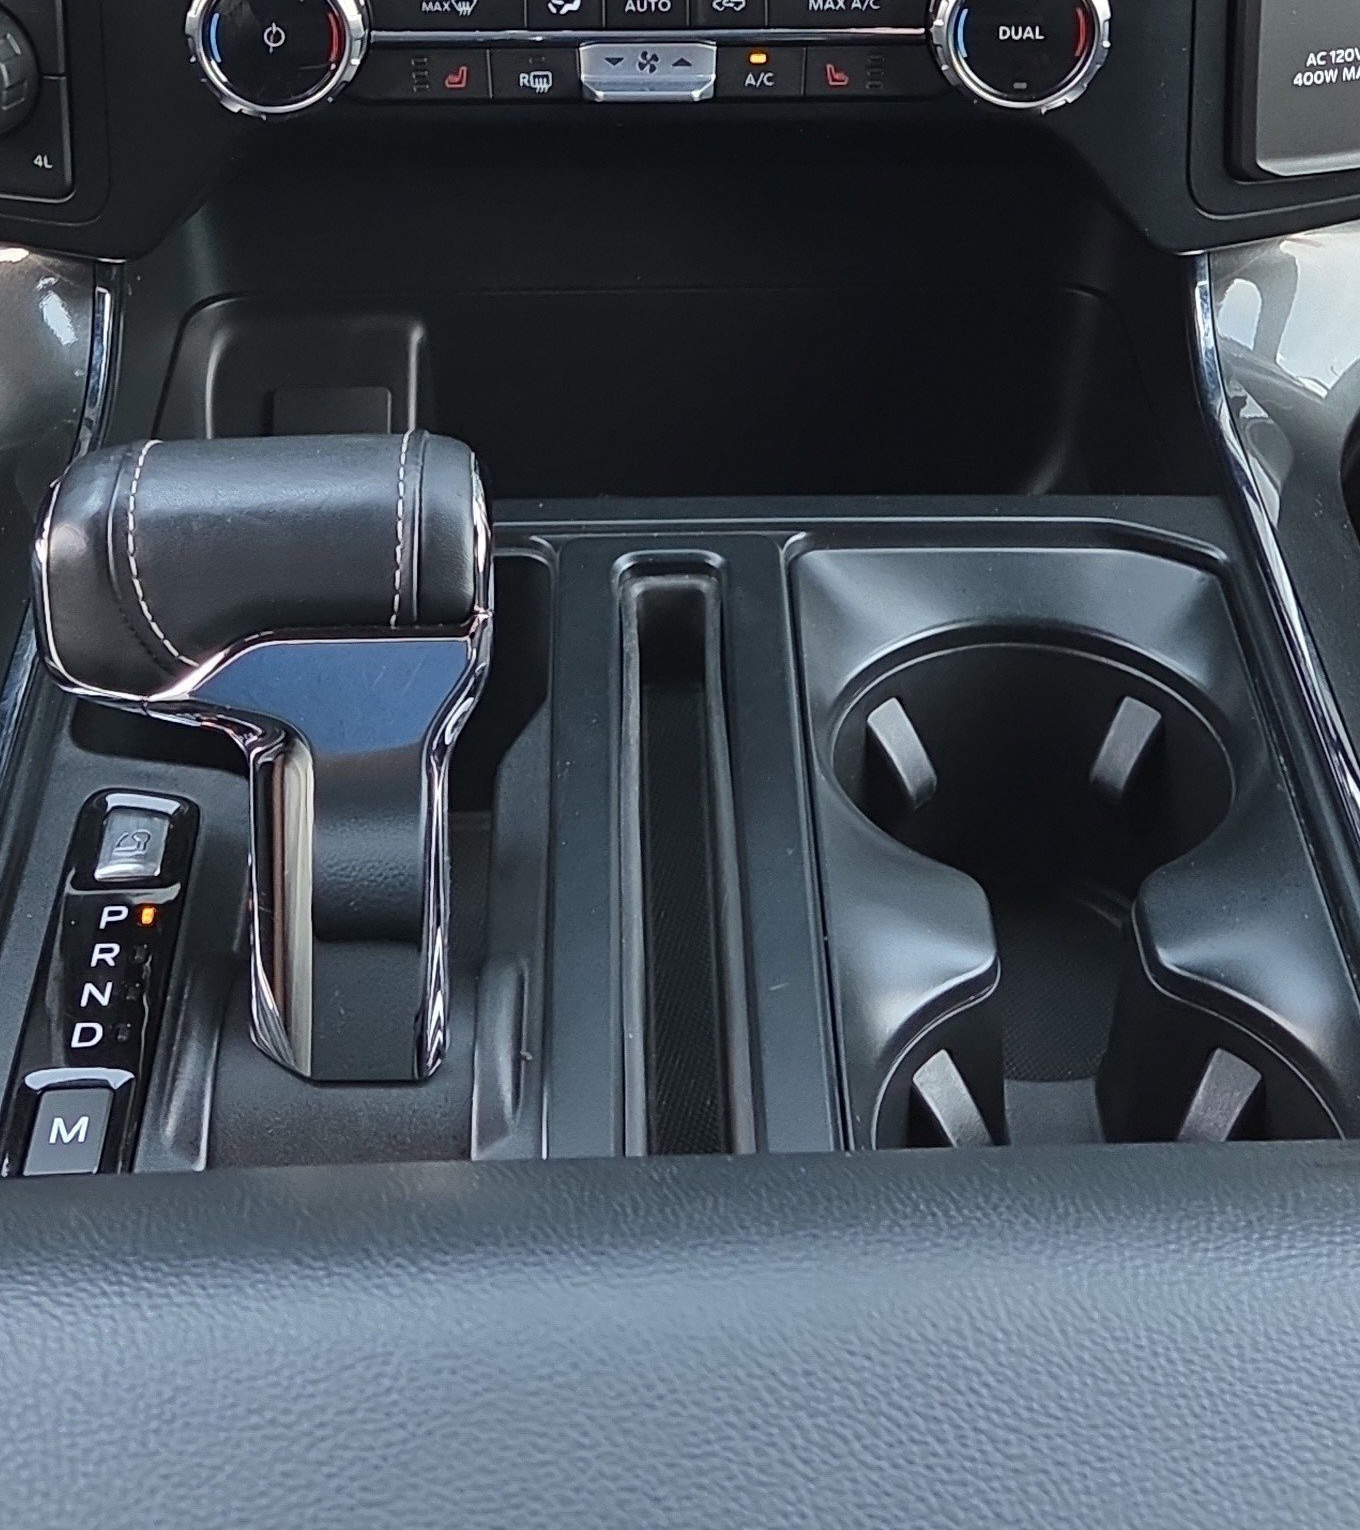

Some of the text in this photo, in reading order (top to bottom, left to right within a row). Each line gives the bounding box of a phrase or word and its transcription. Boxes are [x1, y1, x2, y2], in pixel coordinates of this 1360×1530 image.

[421, 0, 452, 12] MAX
[998, 25, 1045, 41] DUAL
[1306, 51, 1328, 67] AC
[744, 71, 776, 88] A/C
[1292, 68, 1339, 87] 400W
[33, 154, 53, 169] 4L
[98, 905, 129, 930] P
[90, 943, 121, 967] R
[80, 982, 113, 1007] N
[70, 1022, 104, 1049] D
[48, 1115, 91, 1144] M
